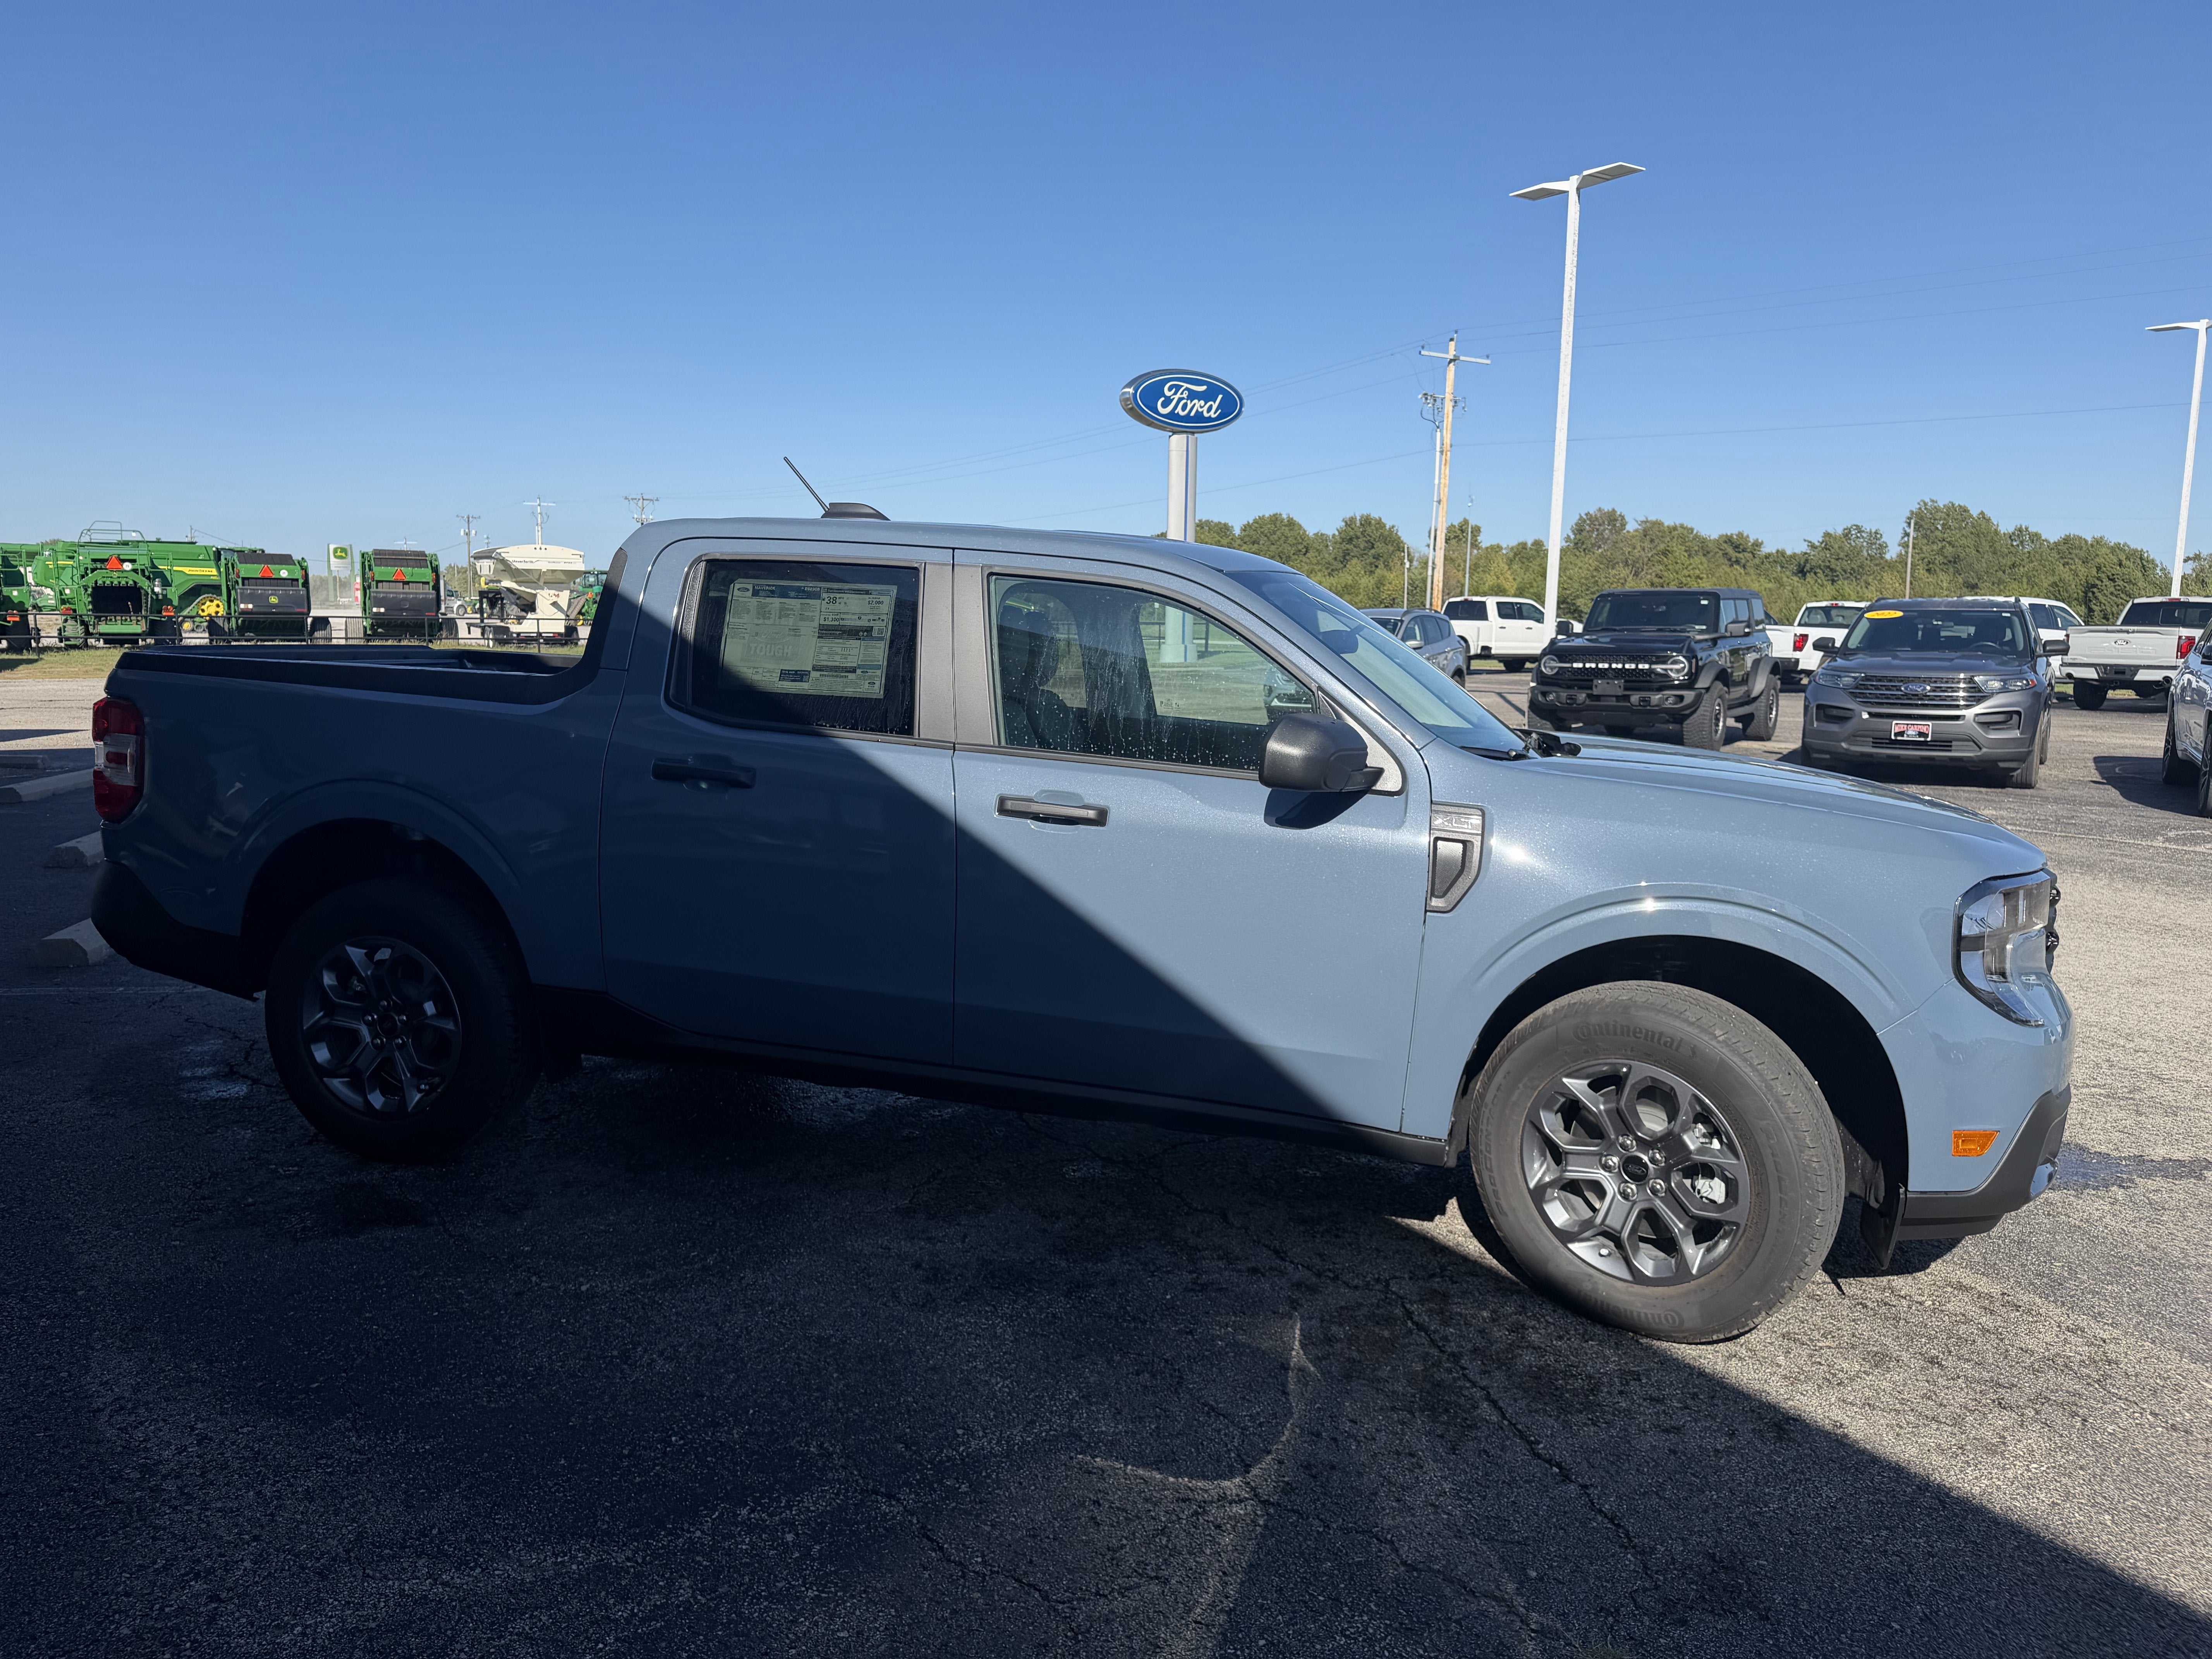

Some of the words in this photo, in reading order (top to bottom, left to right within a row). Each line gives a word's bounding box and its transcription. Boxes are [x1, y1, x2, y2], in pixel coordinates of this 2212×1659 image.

[1157, 381, 1223, 418] Ford
[826, 596, 837, 605] 38
[749, 643, 793, 657] TOUGH
[1434, 816, 1480, 828] XLT
[1572, 1021, 1684, 1053] Continental
